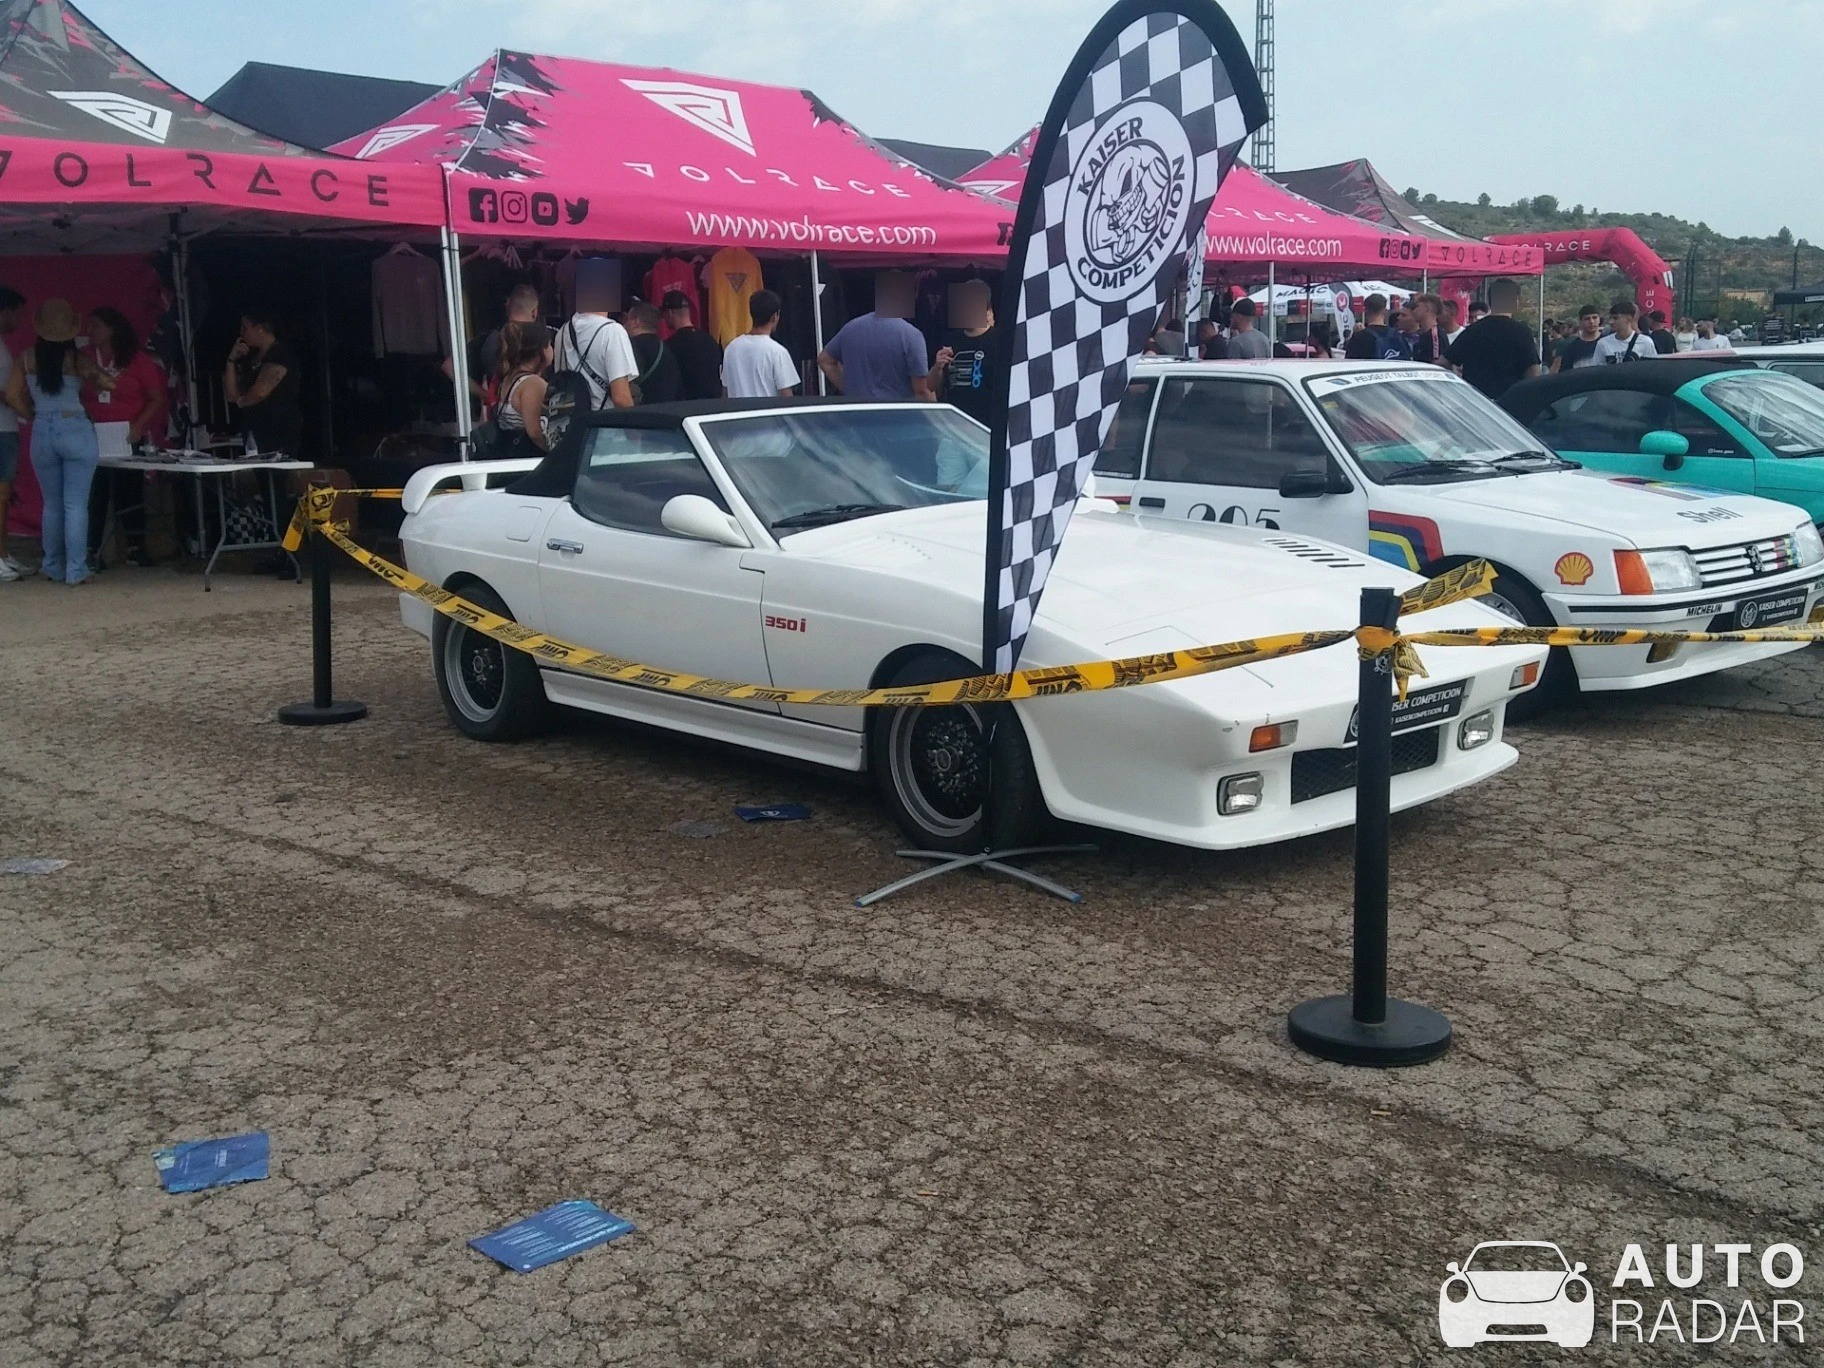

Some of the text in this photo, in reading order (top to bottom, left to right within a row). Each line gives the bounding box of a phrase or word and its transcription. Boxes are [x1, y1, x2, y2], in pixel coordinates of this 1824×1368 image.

[1076, 116, 1143, 196] KAISER
[623, 161, 911, 198] VOLRACE
[685, 210, 936, 246] www.volrace.com
[1078, 154, 1185, 290] COMPETICION
[1441, 246, 1532, 266] VOLRACE
[1354, 372, 1392, 383] PEUGEOT
[1393, 371, 1420, 379] TALBOT
[1676, 506, 1744, 523] Shell
[1686, 603, 1723, 617] MICHELIN
[765, 615, 807, 633] 350i
[1391, 686, 1462, 712] ISER COMPETICION
